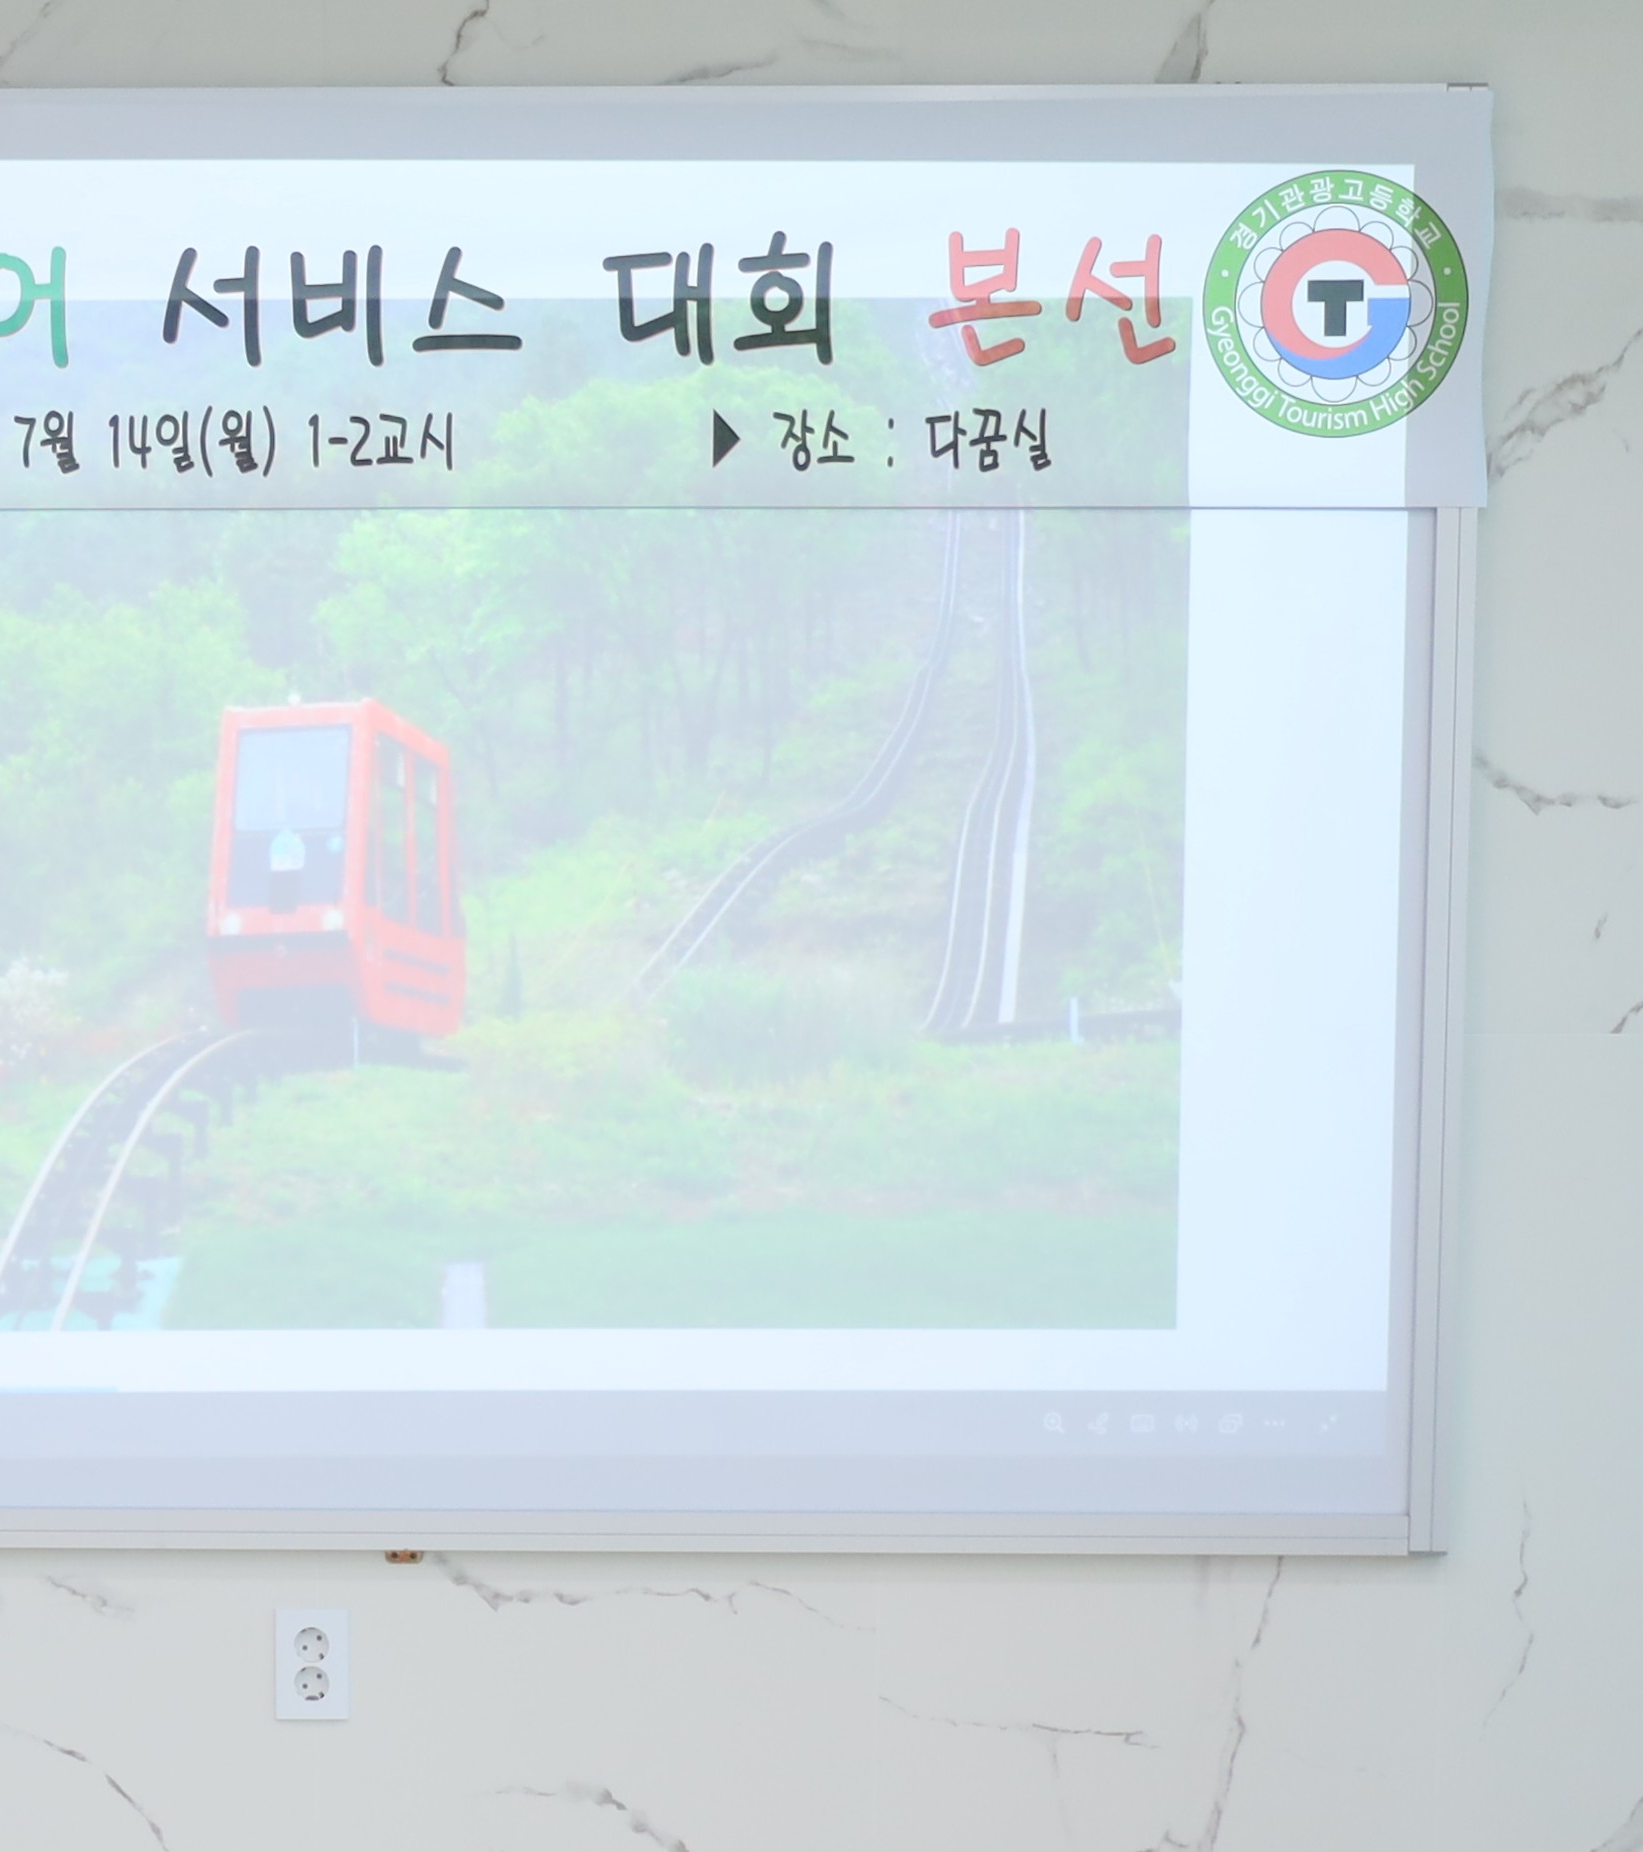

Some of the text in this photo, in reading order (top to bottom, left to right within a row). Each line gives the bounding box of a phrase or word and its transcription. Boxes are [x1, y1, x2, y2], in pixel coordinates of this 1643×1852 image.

[1229, 176, 1442, 251] 경기관광고등학교
[162, 244, 523, 368] 서비스
[602, 230, 834, 366] 대회
[929, 228, 1176, 367] 본선
[1207, 302, 1461, 431] Gyeonggi Tourism High School
[13, 410, 81, 475] 7월
[108, 405, 276, 478] 14일(월)
[308, 411, 453, 471] 1-2교시
[772, 408, 856, 472] 장소
[924, 407, 1052, 473] 다꿈실
